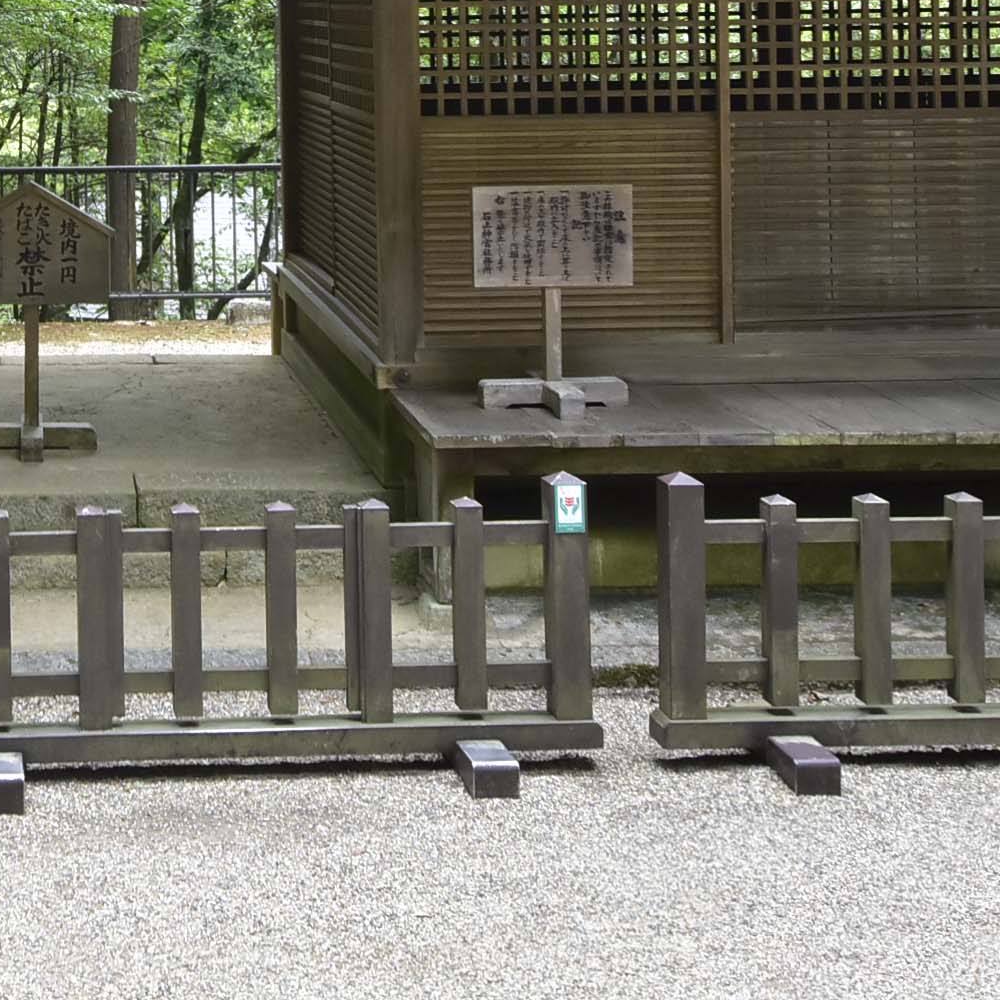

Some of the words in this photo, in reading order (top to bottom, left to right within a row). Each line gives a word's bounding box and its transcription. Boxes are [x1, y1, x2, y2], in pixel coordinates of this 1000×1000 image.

[34, 202, 52, 245] たき火
[16, 246, 51, 298] 禁止
[59, 218, 81, 284] 境内一円
